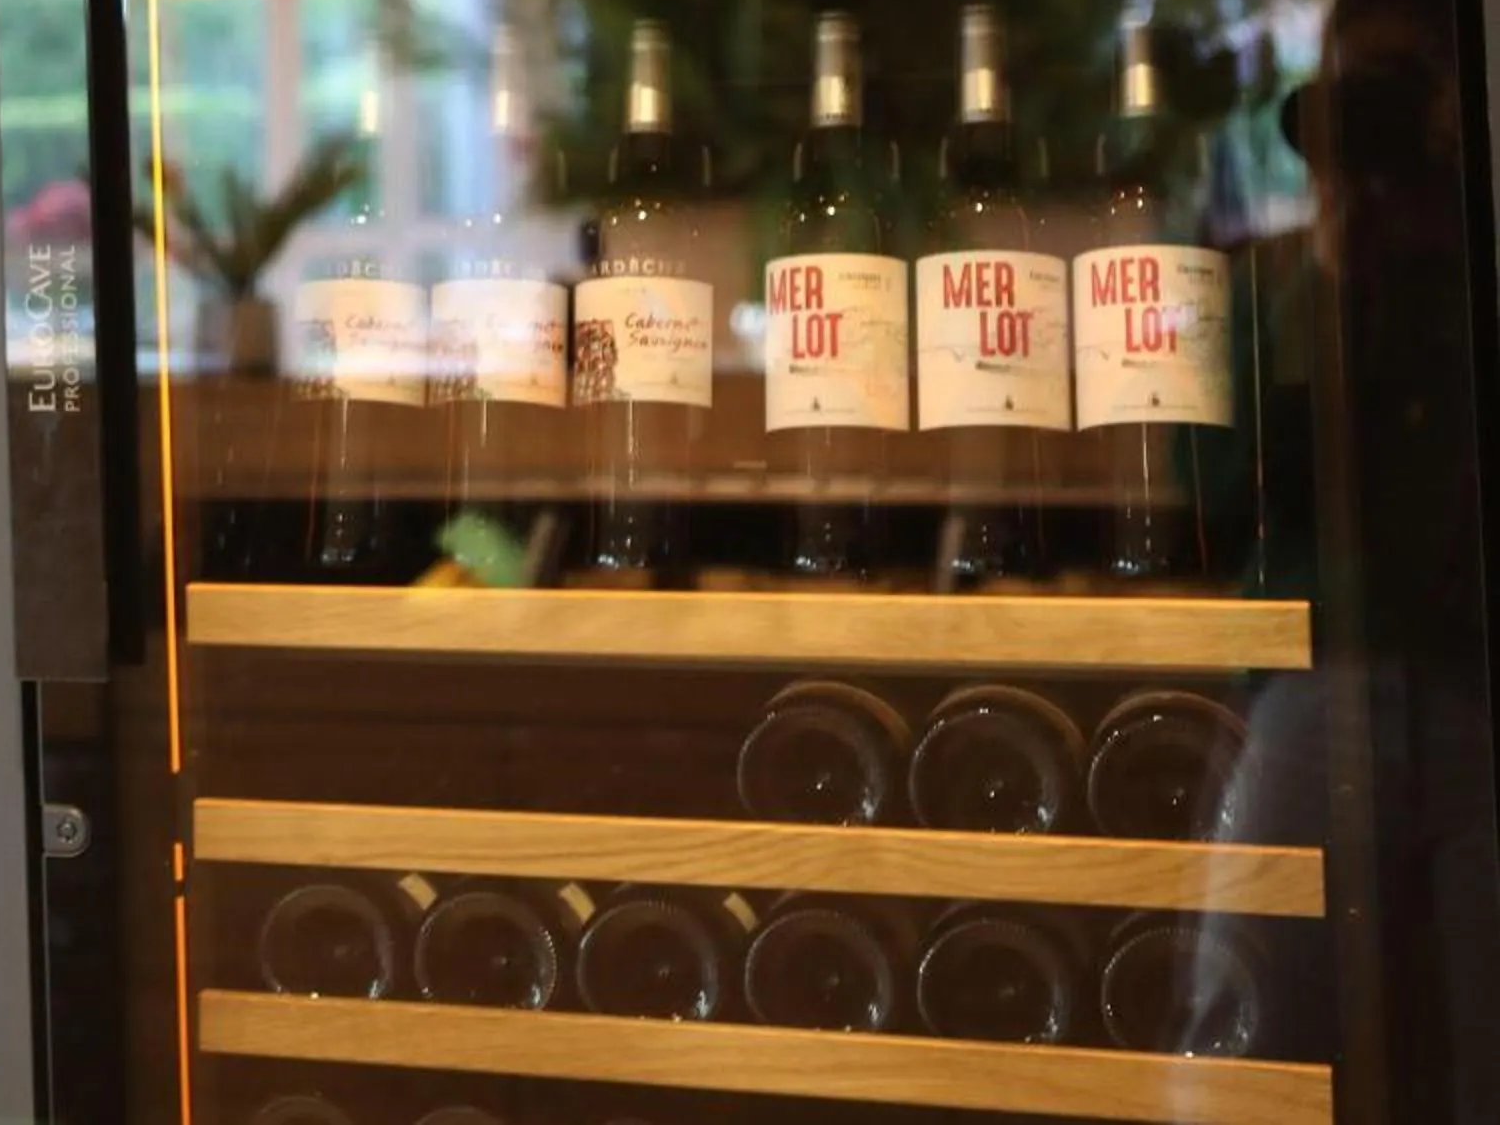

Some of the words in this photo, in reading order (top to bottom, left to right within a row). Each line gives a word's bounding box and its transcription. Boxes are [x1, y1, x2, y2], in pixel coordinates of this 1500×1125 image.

[769, 265, 824, 315] MER
[942, 261, 1015, 309] MER
[1091, 256, 1161, 308] MER
[791, 312, 843, 359] LOT
[979, 310, 1034, 357] LOT
